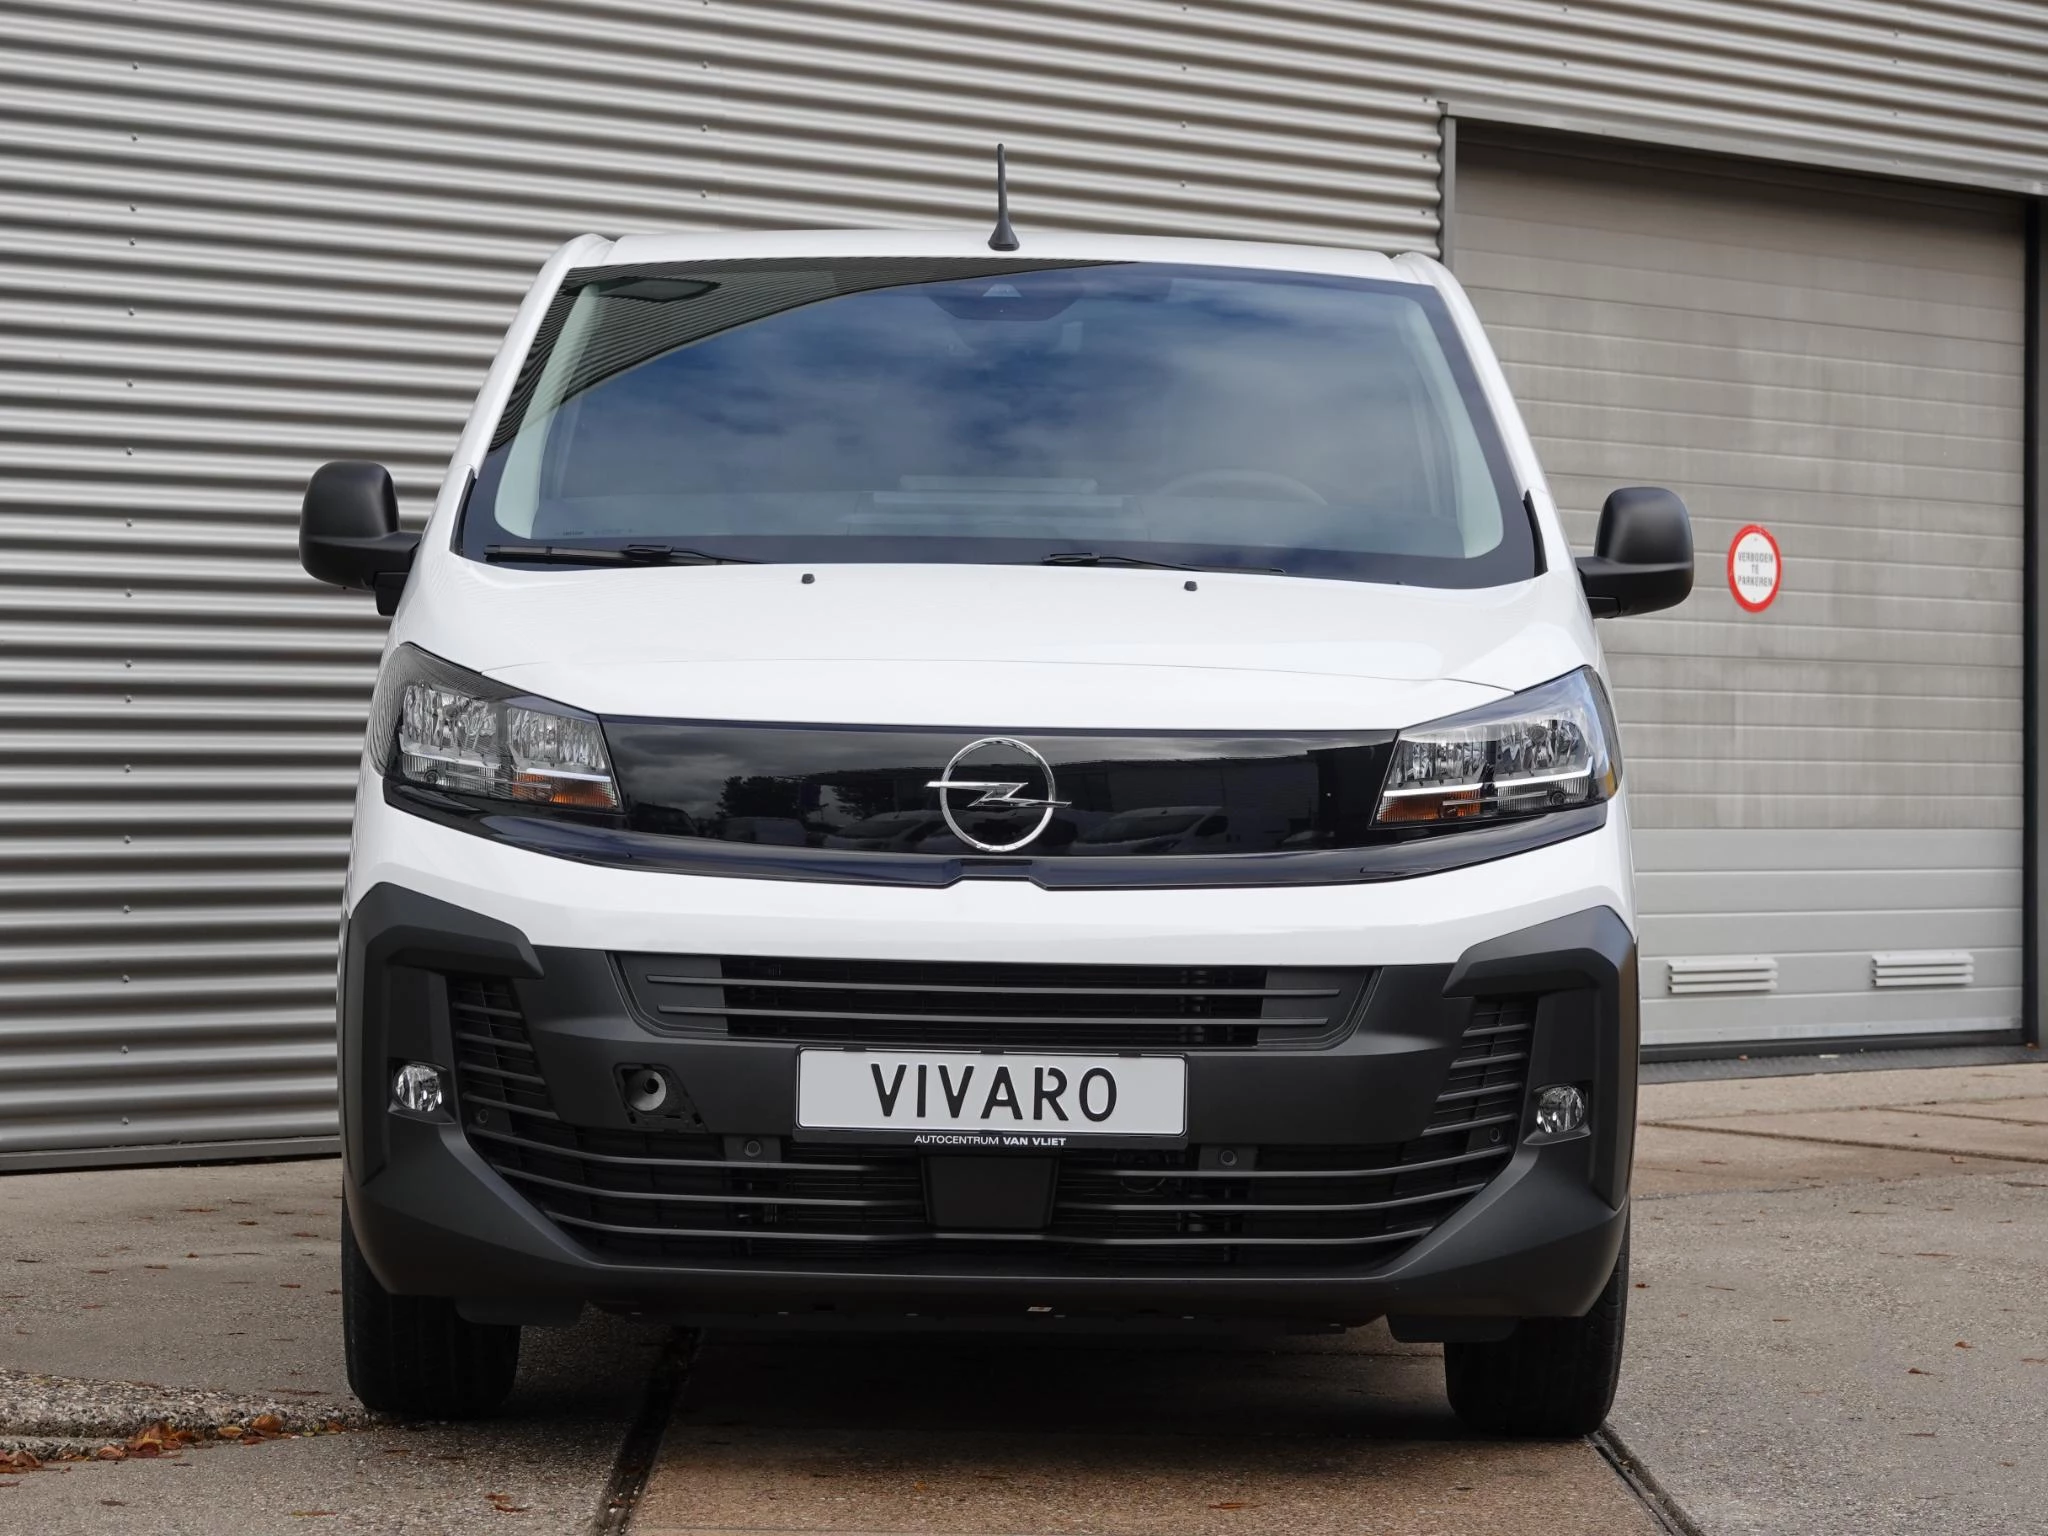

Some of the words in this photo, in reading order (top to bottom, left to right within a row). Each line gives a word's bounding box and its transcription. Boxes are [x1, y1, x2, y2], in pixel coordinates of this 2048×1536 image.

[1738, 552, 1773, 563] VERBODEN
[1751, 564, 1759, 575] TE
[1738, 576, 1773, 587] PARKEREN
[870, 1063, 1117, 1122] VIVARO
[914, 1135, 999, 1145] AUTOCENTRUM
[1002, 1136, 1028, 1146] VAN
[1032, 1137, 1067, 1146] VLIET
